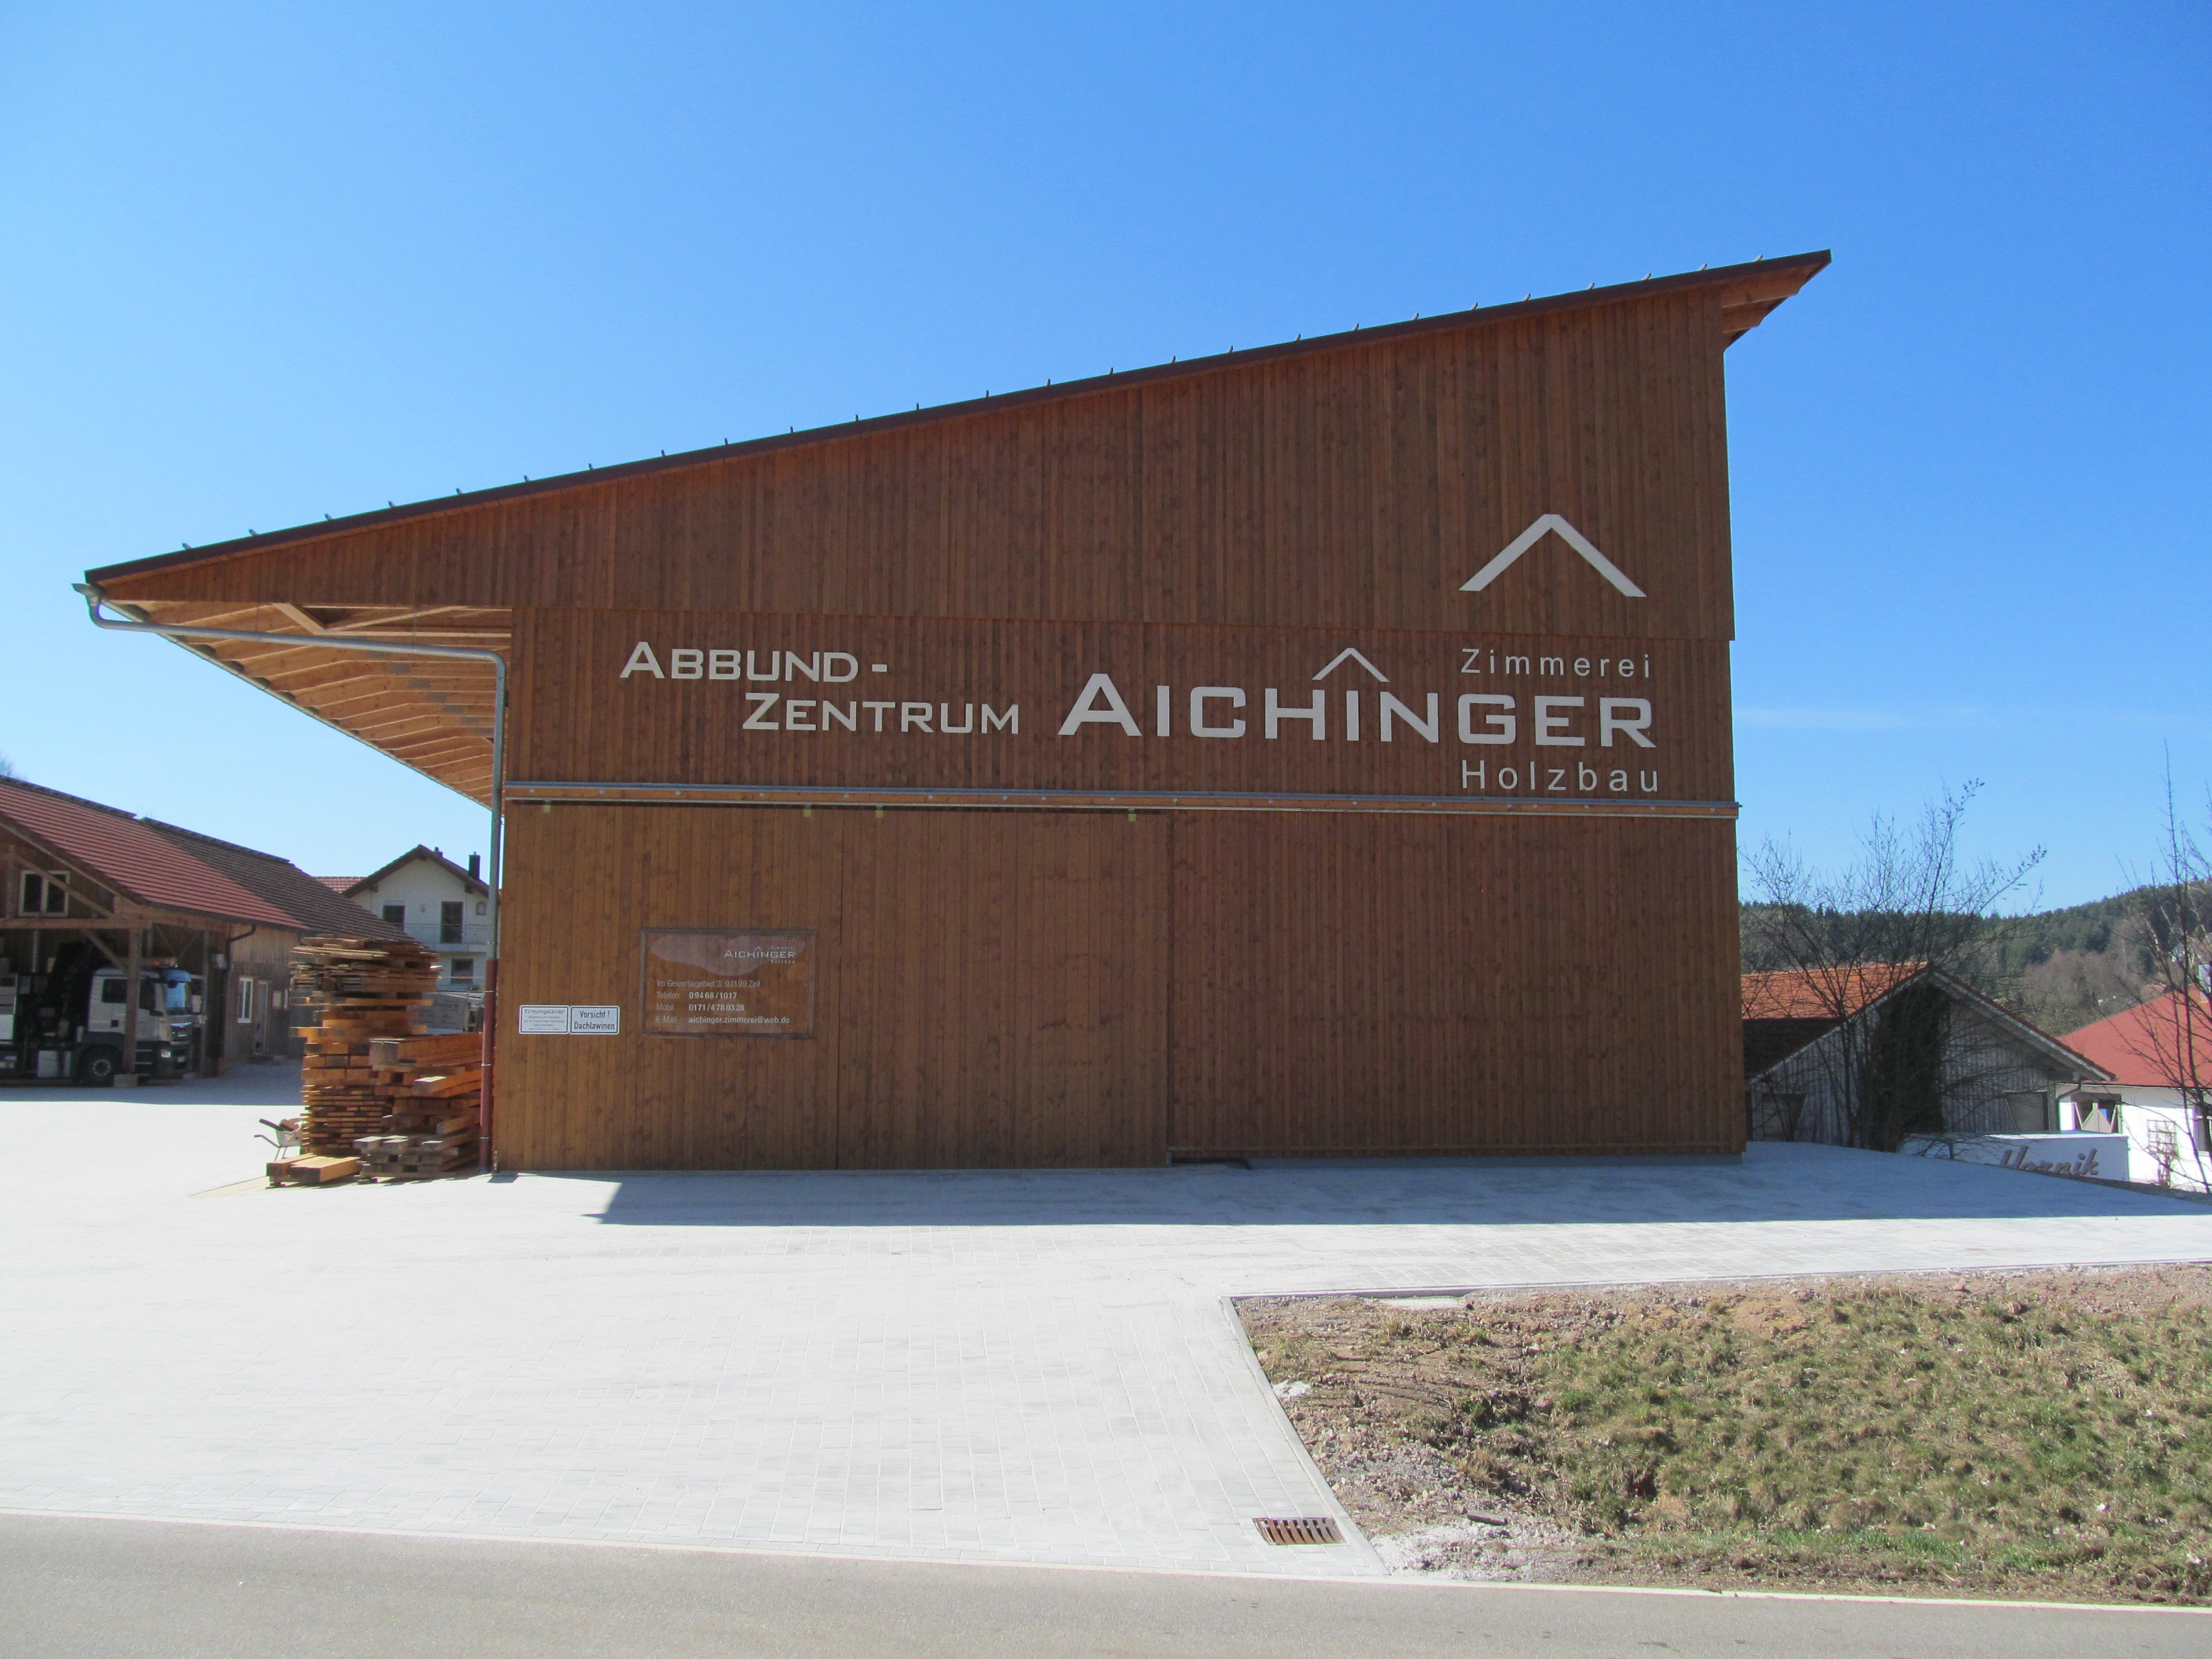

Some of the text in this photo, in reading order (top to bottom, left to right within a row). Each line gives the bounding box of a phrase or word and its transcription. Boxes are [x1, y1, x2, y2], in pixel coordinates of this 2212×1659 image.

[1460, 648, 1649, 678] Zimmerei
[742, 692, 1019, 735] ZENTRUM
[1057, 672, 1657, 749] AICHINGER
[1461, 759, 1658, 793] Holzbau
[724, 950, 795, 959] AICHINGER
[667, 980, 715, 988] Gewerbegebiet
[689, 1016, 790, 1024] aichinger.zimmerei@web.de
